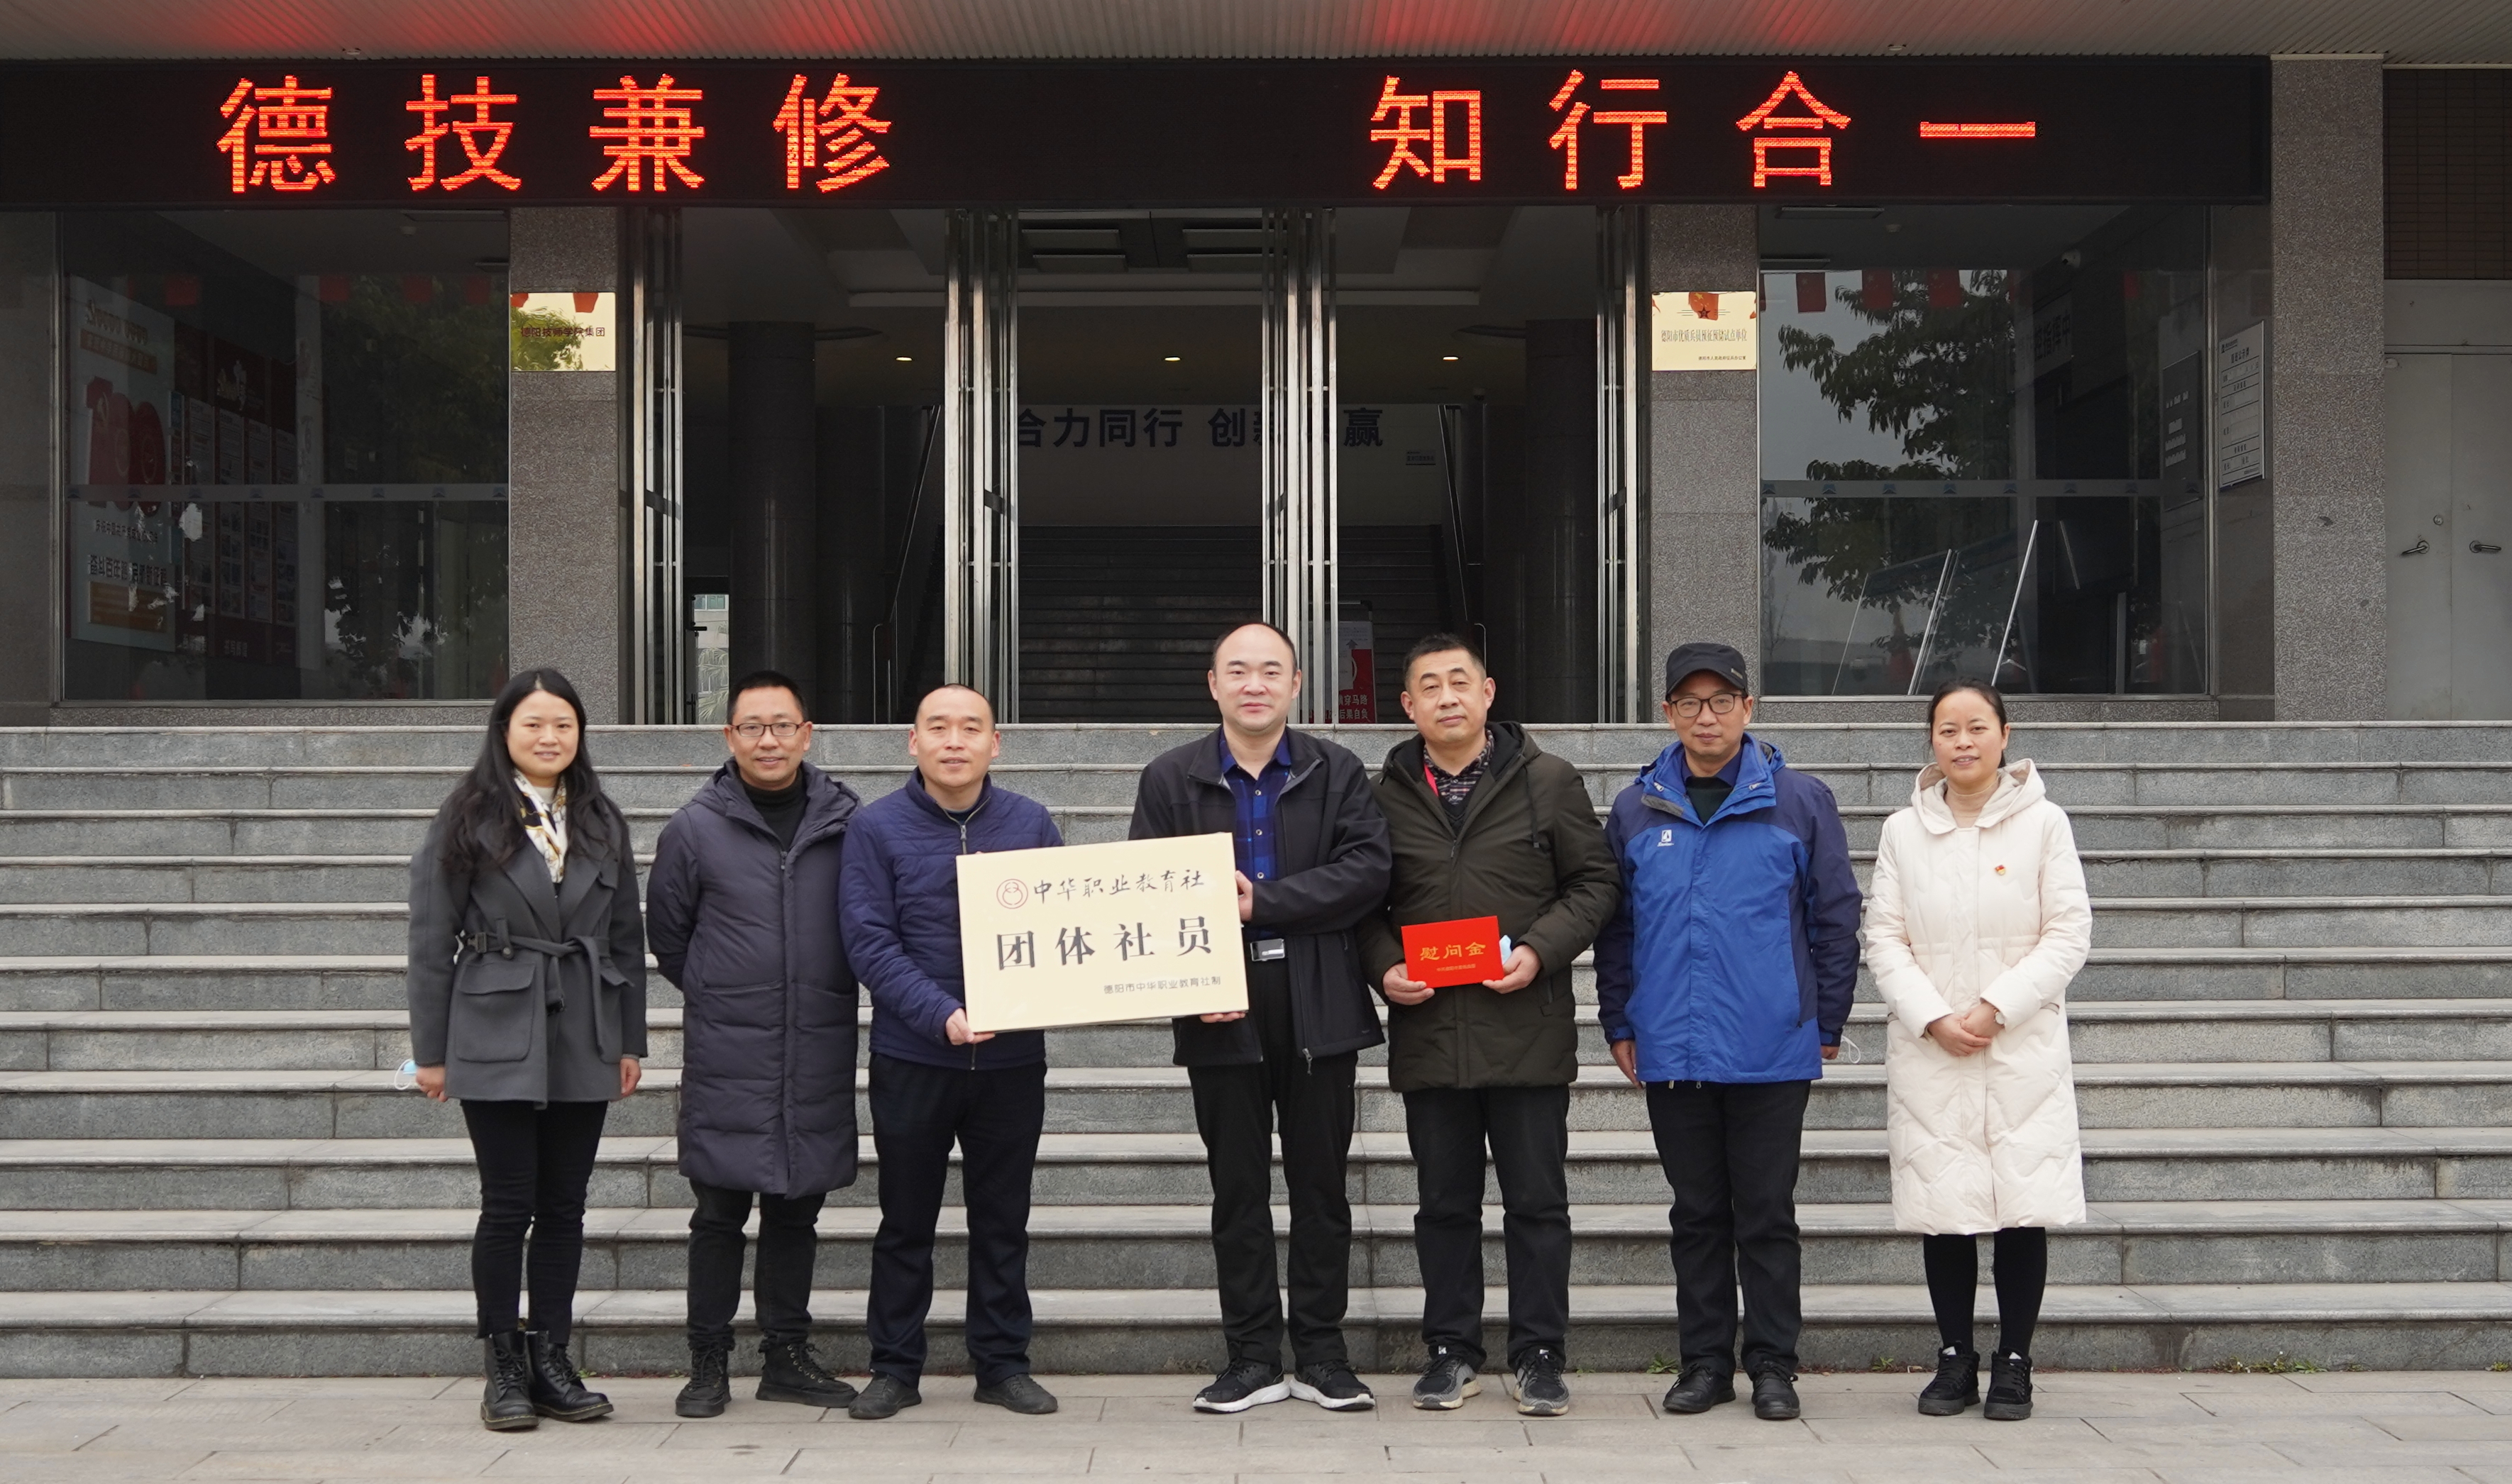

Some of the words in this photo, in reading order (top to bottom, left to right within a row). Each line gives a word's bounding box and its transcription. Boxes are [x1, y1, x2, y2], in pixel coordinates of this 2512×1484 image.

[217, 73, 892, 193] 德技兼修
[1370, 70, 2036, 190] 知行合一
[521, 327, 605, 338] 德阳技师学院集团
[1018, 408, 1183, 448] 合力同行
[1208, 408, 1384, 448] 创赢
[1033, 869, 1205, 904] 中华职业教育社
[996, 915, 1212, 970] 团体社员
[1419, 941, 1487, 961] 慰问金
[1103, 976, 1221, 995] 德阳市中华职业教育社制
